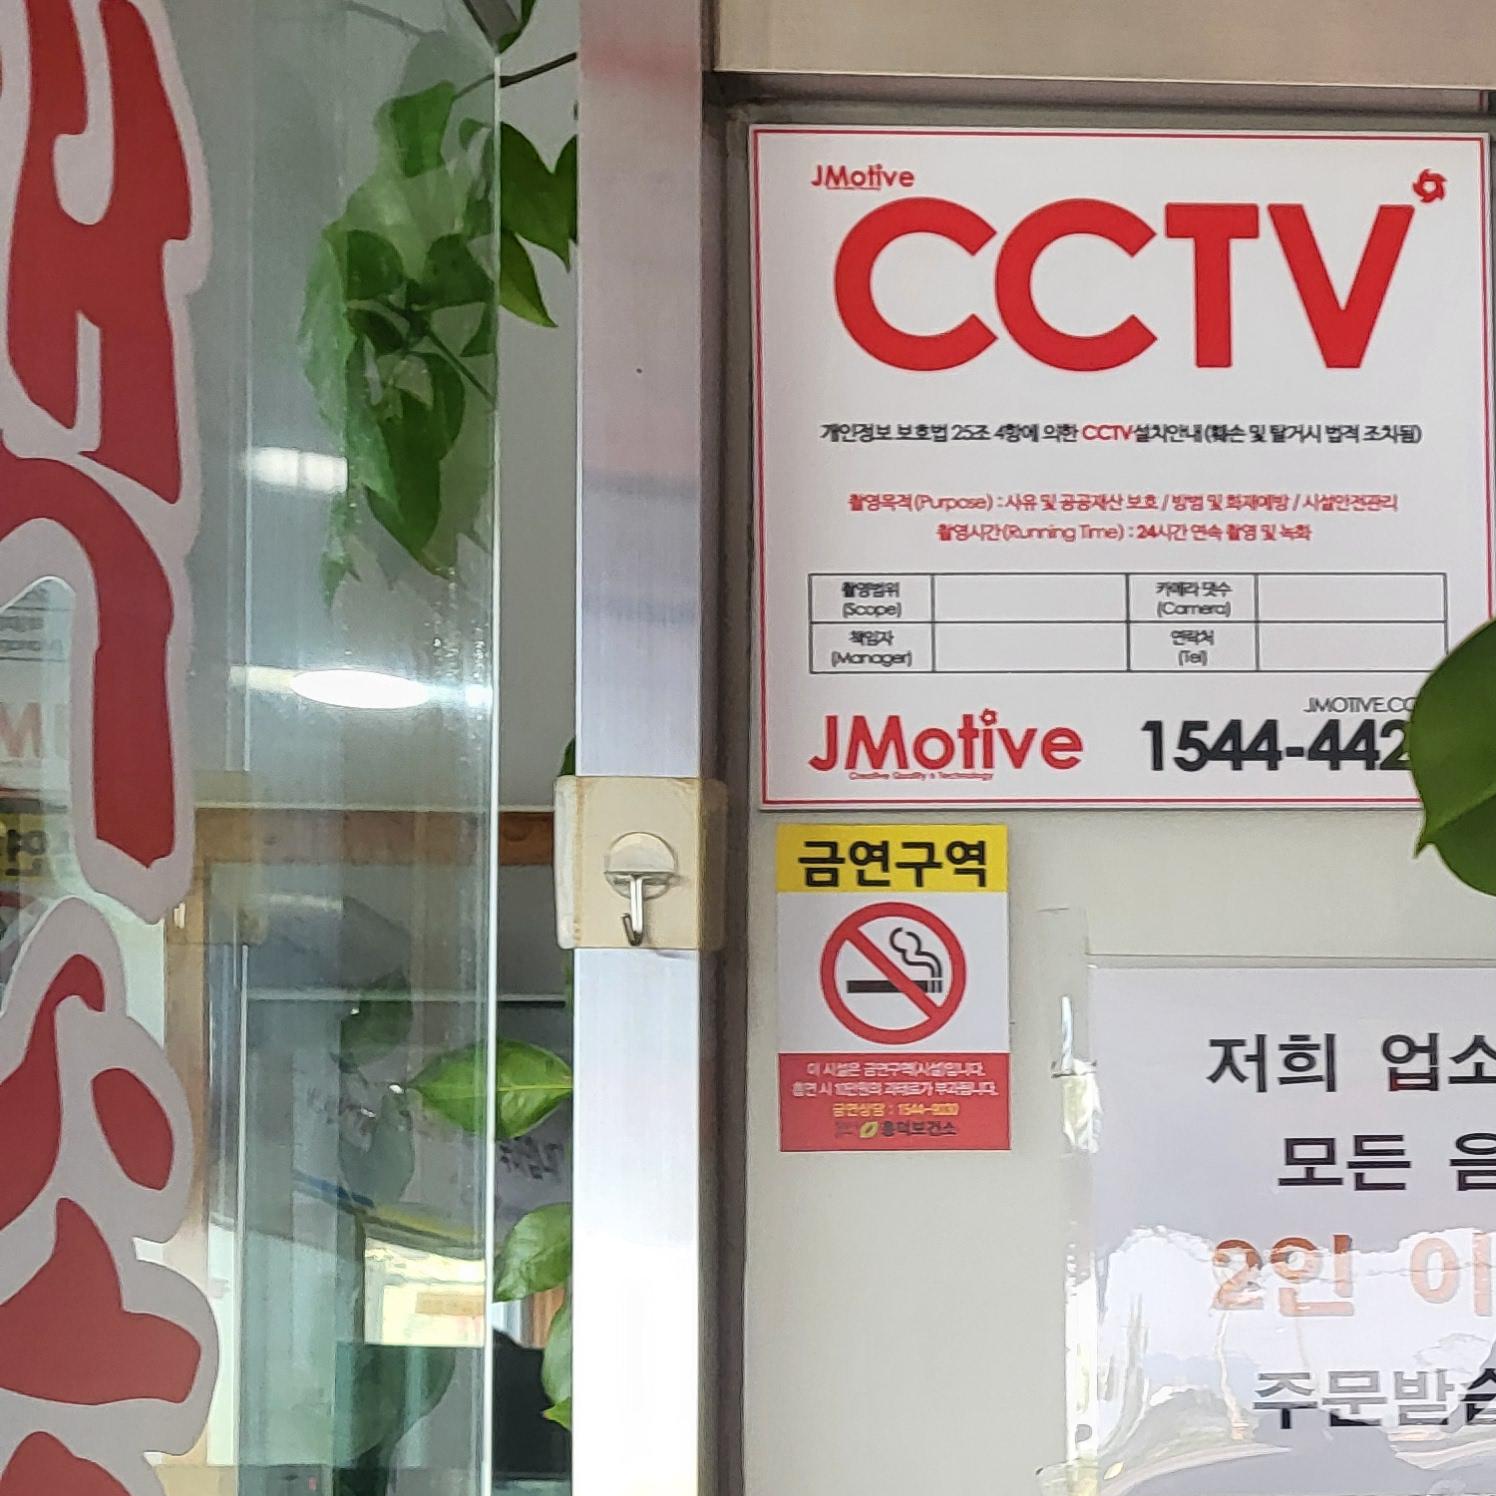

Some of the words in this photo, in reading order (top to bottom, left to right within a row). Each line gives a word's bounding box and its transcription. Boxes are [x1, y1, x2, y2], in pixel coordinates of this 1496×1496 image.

[811, 163, 915, 187] JMotive
[833, 196, 1415, 372] CCTV
[820, 424, 893, 443] 개인정보
[899, 424, 947, 443] 보호법
[951, 424, 990, 443] 25조
[995, 424, 1039, 443] 4항에
[1043, 424, 1078, 443] 의한
[1249, 424, 1266, 443] 및
[1269, 424, 1321, 443] 탈거시
[1325, 424, 1359, 443] 법적
[1362, 424, 1423, 443] 조치됨)
[1005, 493, 1037, 511] 사유
[1040, 493, 1056, 511] 및
[1059, 493, 1123, 511] 공공재산
[1126, 493, 1158, 511] 보호
[1172, 493, 1203, 511] 방범
[1207, 493, 1223, 511] 및
[1226, 493, 1289, 511] 화재예방
[1303, 493, 1398, 511] 시설안전관리
[1136, 523, 1186, 541] 24시간
[1190, 523, 1222, 541] 연속
[1225, 523, 1257, 541] 촬영
[1261, 523, 1276, 541] 및
[1279, 523, 1312, 541] 녹화
[1156, 601, 1231, 618] (Camera)
[848, 630, 894, 646] 책임자
[1170, 629, 1214, 646] 연락처
[1178, 650, 1208, 667] (Tel)
[1303, 696, 1418, 713] JMOTIVE.CO
[808, 708, 1084, 772] JMotive
[1140, 718, 1412, 772] 1544-442
[797, 839, 988, 888] 금연구역
[1205, 1031, 1339, 1094] 저희
[832, 1102, 886, 1117] 금연상담
[1276, 1133, 1412, 1194] 모든
[1210, 1233, 1355, 1320] 2인
